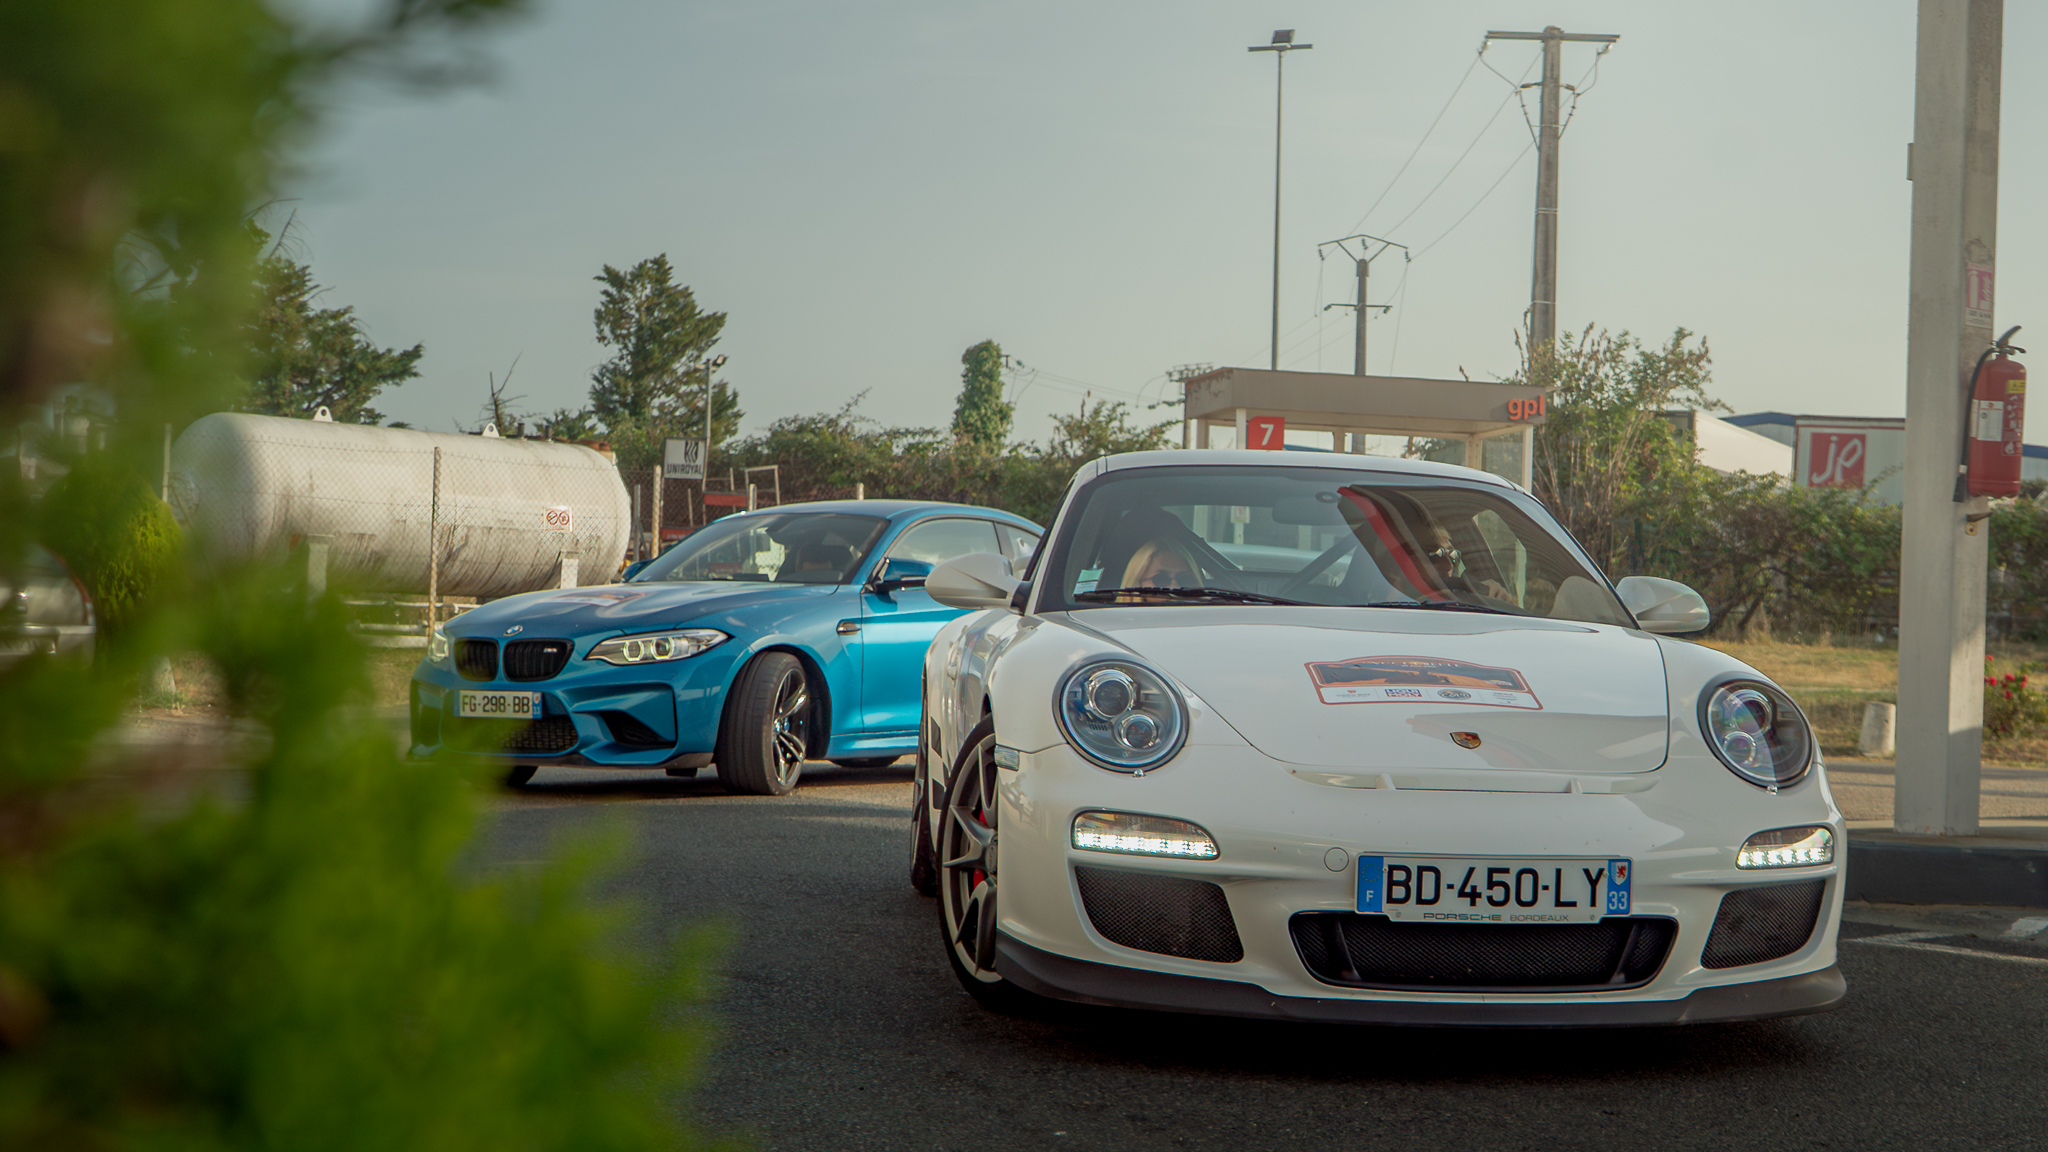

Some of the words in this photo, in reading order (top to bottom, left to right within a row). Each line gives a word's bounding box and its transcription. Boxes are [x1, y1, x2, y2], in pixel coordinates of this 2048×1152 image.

[1508, 394, 1544, 420] gpl
[1260, 423, 1274, 446] 7
[666, 463, 702, 475] UNIROYAL
[462, 695, 530, 713] FG-298-BB
[1386, 864, 1606, 907] BD-450-LY
[1366, 890, 1374, 902] F
[1608, 891, 1627, 910] 33
[1423, 912, 1502, 921] PORSCHE
[1510, 914, 1569, 922] BORDEAUX
